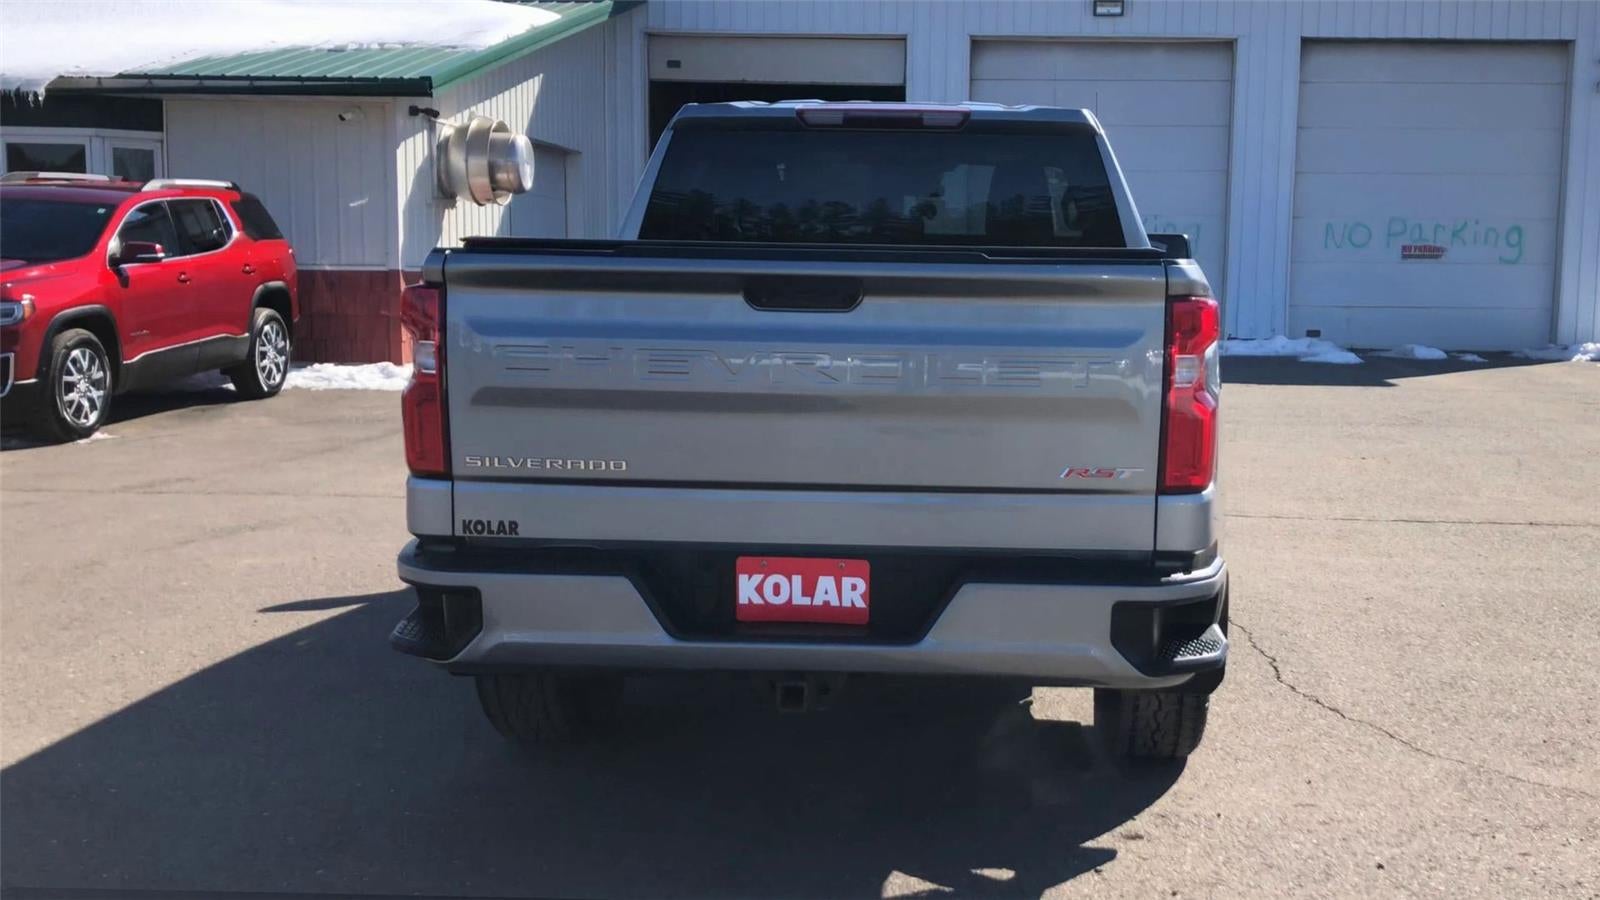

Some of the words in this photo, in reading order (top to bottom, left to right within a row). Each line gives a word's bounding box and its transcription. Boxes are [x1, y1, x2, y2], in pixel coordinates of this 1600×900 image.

[491, 344, 1114, 388] CHEVROLET
[465, 455, 627, 472] SILVERADO
[1060, 466, 1145, 480] RST
[462, 519, 520, 536] KOLAR
[738, 573, 867, 608] KOLAR
